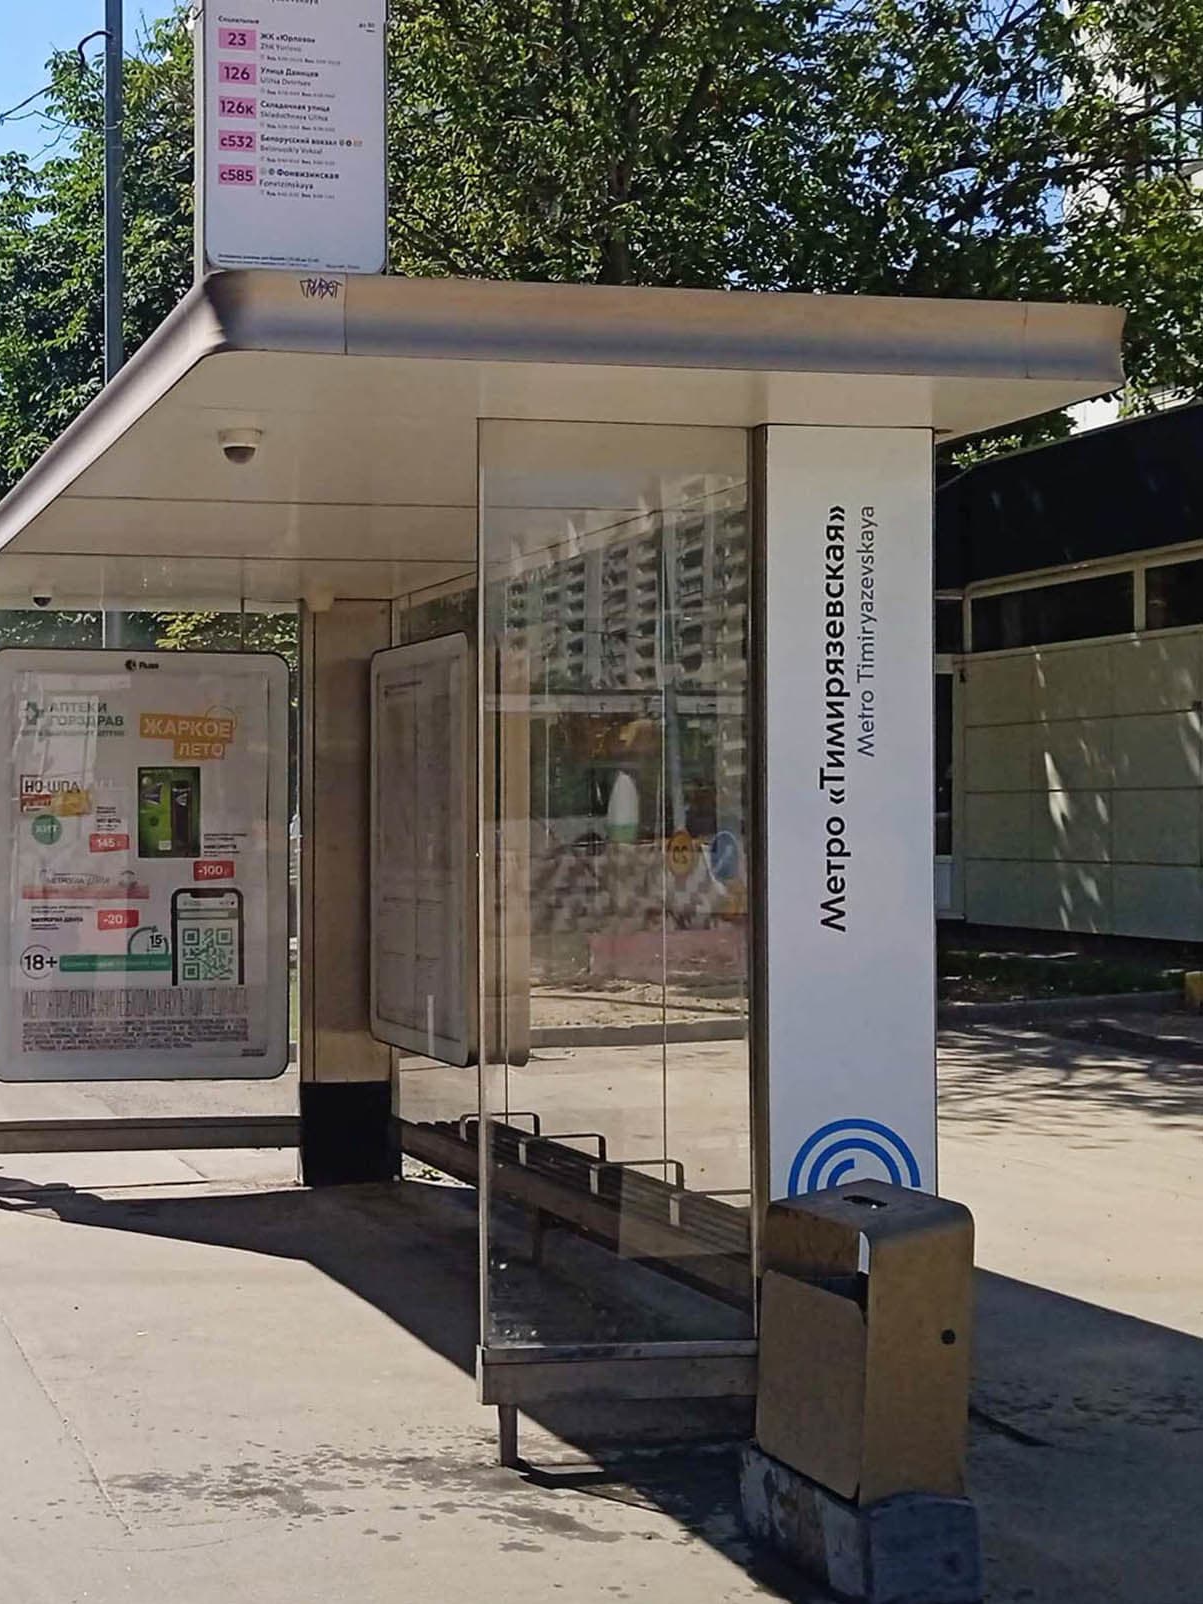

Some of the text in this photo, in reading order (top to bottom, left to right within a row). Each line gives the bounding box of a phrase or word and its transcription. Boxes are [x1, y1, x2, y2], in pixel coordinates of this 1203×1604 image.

[228, 33, 247, 46] 23
[224, 66, 250, 81] 126
[277, 168, 339, 179] Фонвизинская
[856, 505, 878, 757] Metro Timiryazevskaya
[819, 505, 851, 932] Метро «Тимирязевская»
[143, 718, 231, 738] ЖАРКОЕ
[179, 743, 224, 756] ЛЕТО
[25, 780, 81, 793] НО-ШПА
[103, 914, 124, 925] -20
[150, 934, 163, 945] 15
[24, 954, 58, 970] 18+
